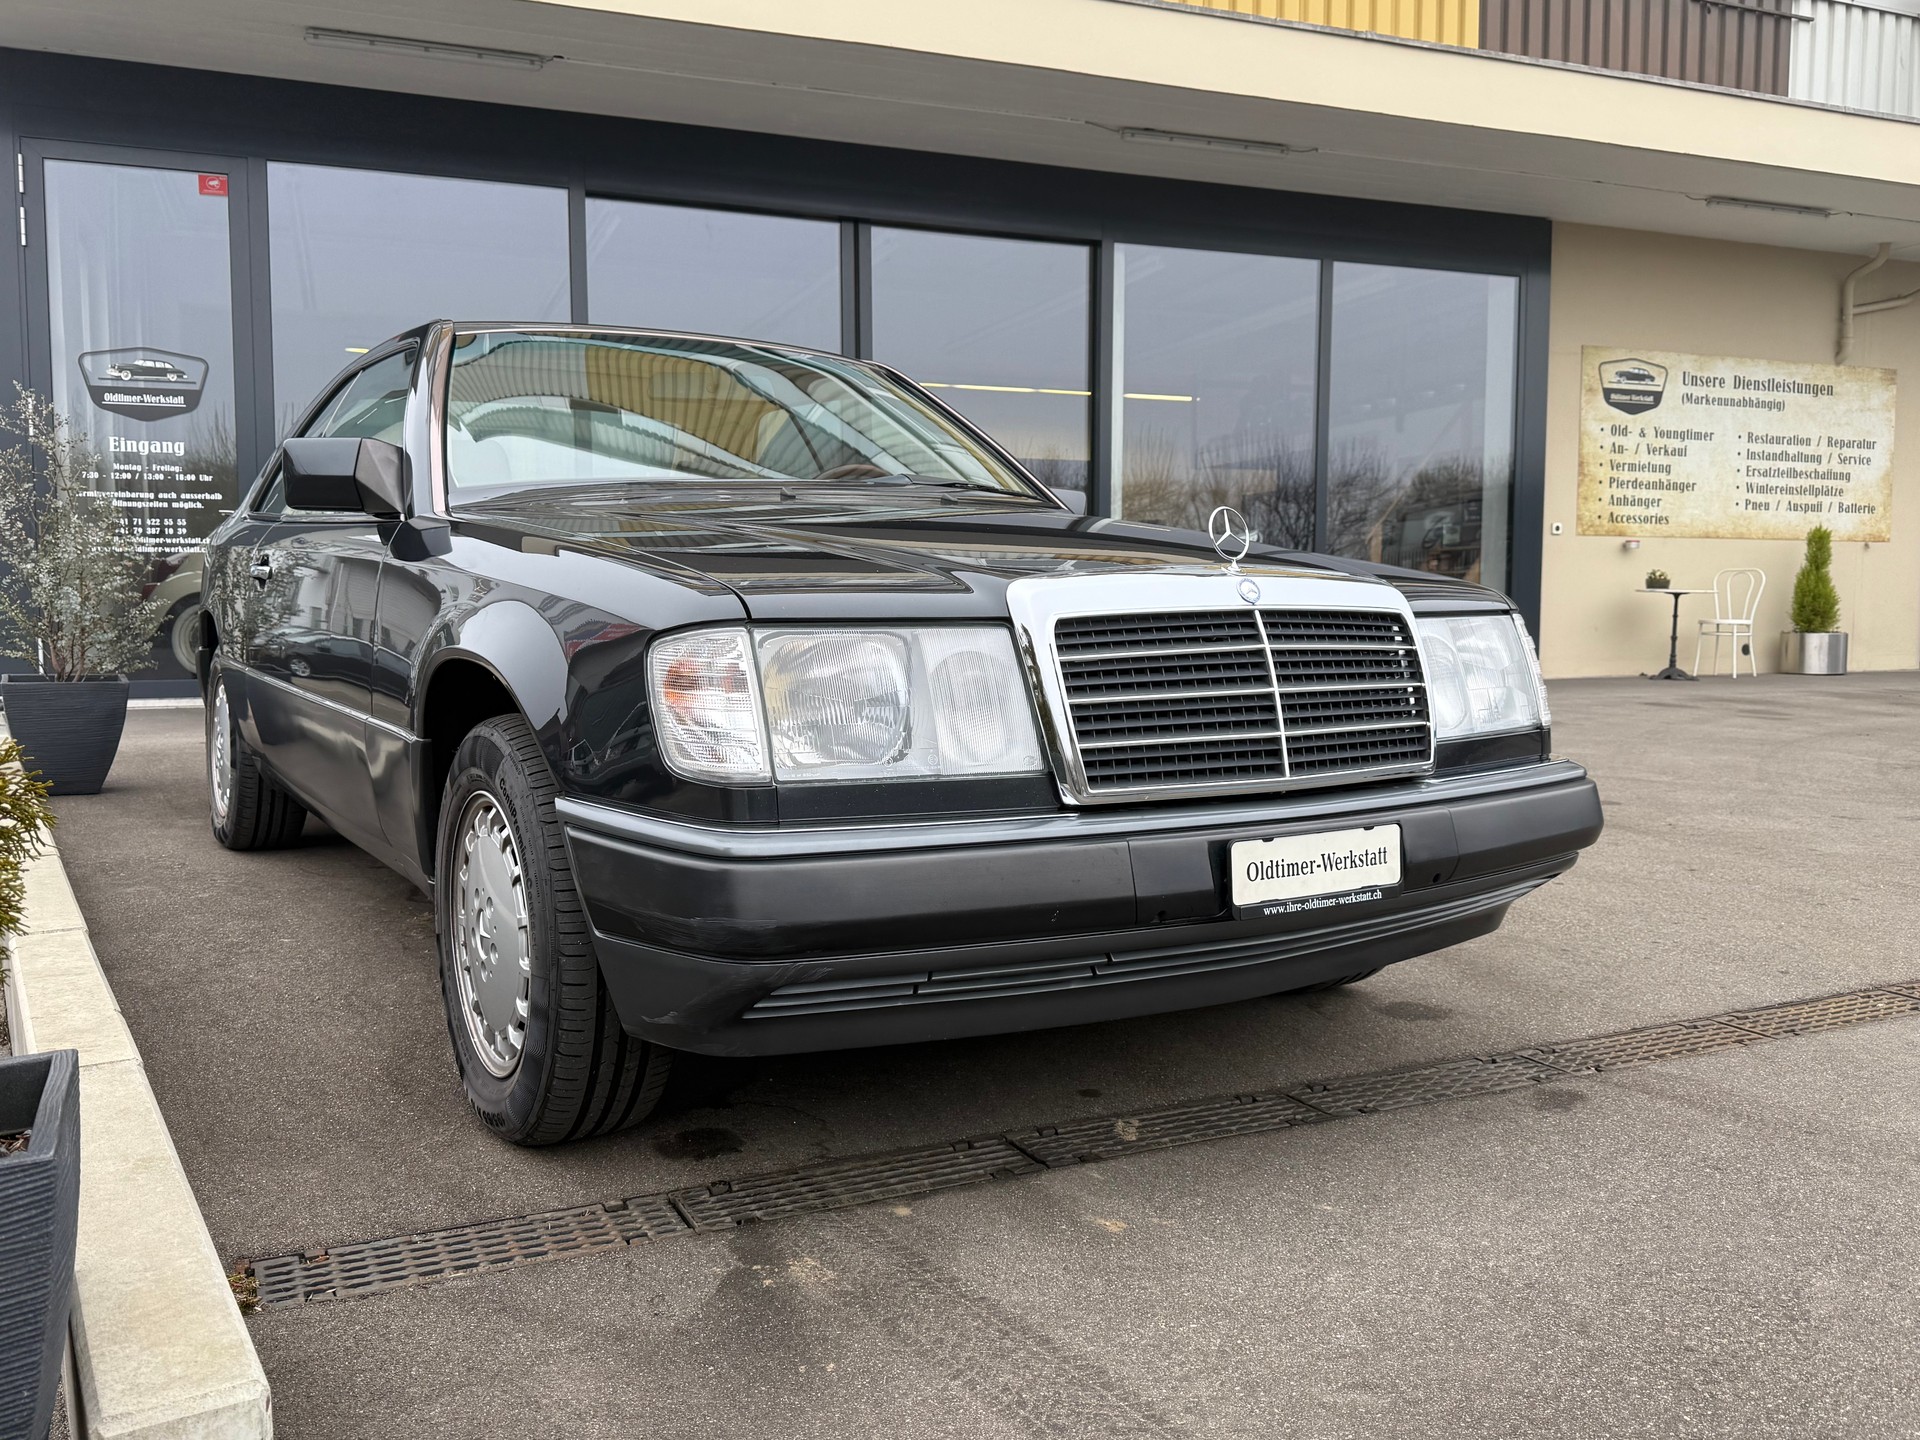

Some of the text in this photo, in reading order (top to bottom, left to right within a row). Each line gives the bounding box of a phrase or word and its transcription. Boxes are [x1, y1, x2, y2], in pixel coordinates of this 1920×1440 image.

[1682, 371, 1834, 397] Unsere Dienstleistungen
[104, 392, 184, 404] Oldtimer-Werkstatt
[1681, 392, 1785, 412] (Markenunabhängig)
[1611, 424, 1715, 442] Old- & Youngtimer
[1747, 432, 1812, 447] Restauration
[1827, 436, 1877, 450] Reparatur
[108, 436, 185, 456] Eingang
[1610, 442, 1629, 455] An-
[1646, 443, 1688, 457] Verkauf
[1746, 448, 1822, 465] Instandhaltung
[1837, 452, 1872, 466] Service
[113, 463, 141, 472] Montag
[152, 464, 183, 473] Freitag:
[1610, 459, 1672, 476] Vermietung
[1746, 465, 1851, 483] Ersatzteilbeschaffung
[110, 472, 132, 480] 12:00
[199, 474, 213, 482] Uhr
[1609, 477, 1697, 493] Pferdeanhänger
[158, 491, 177, 499] auch
[180, 492, 223, 500] ausserhalb
[1745, 482, 1844, 498] Wintereinstellplätze
[171, 500, 205, 510] möglich.
[1608, 494, 1662, 510] Anhänger
[1745, 499, 1770, 511] Pneu
[1786, 500, 1823, 514] Auspuff
[1837, 502, 1876, 514] Batterie
[146, 518, 160, 526] 422
[163, 518, 174, 526] 55
[1607, 512, 1670, 525] Accessories
[133, 527, 143, 535] 79
[146, 527, 160, 535] 387
[1246, 846, 1388, 882] Oldtimer-Werkstatt
[1263, 889, 1382, 916] www.ihre-oldtimer-werkstatt.ch
